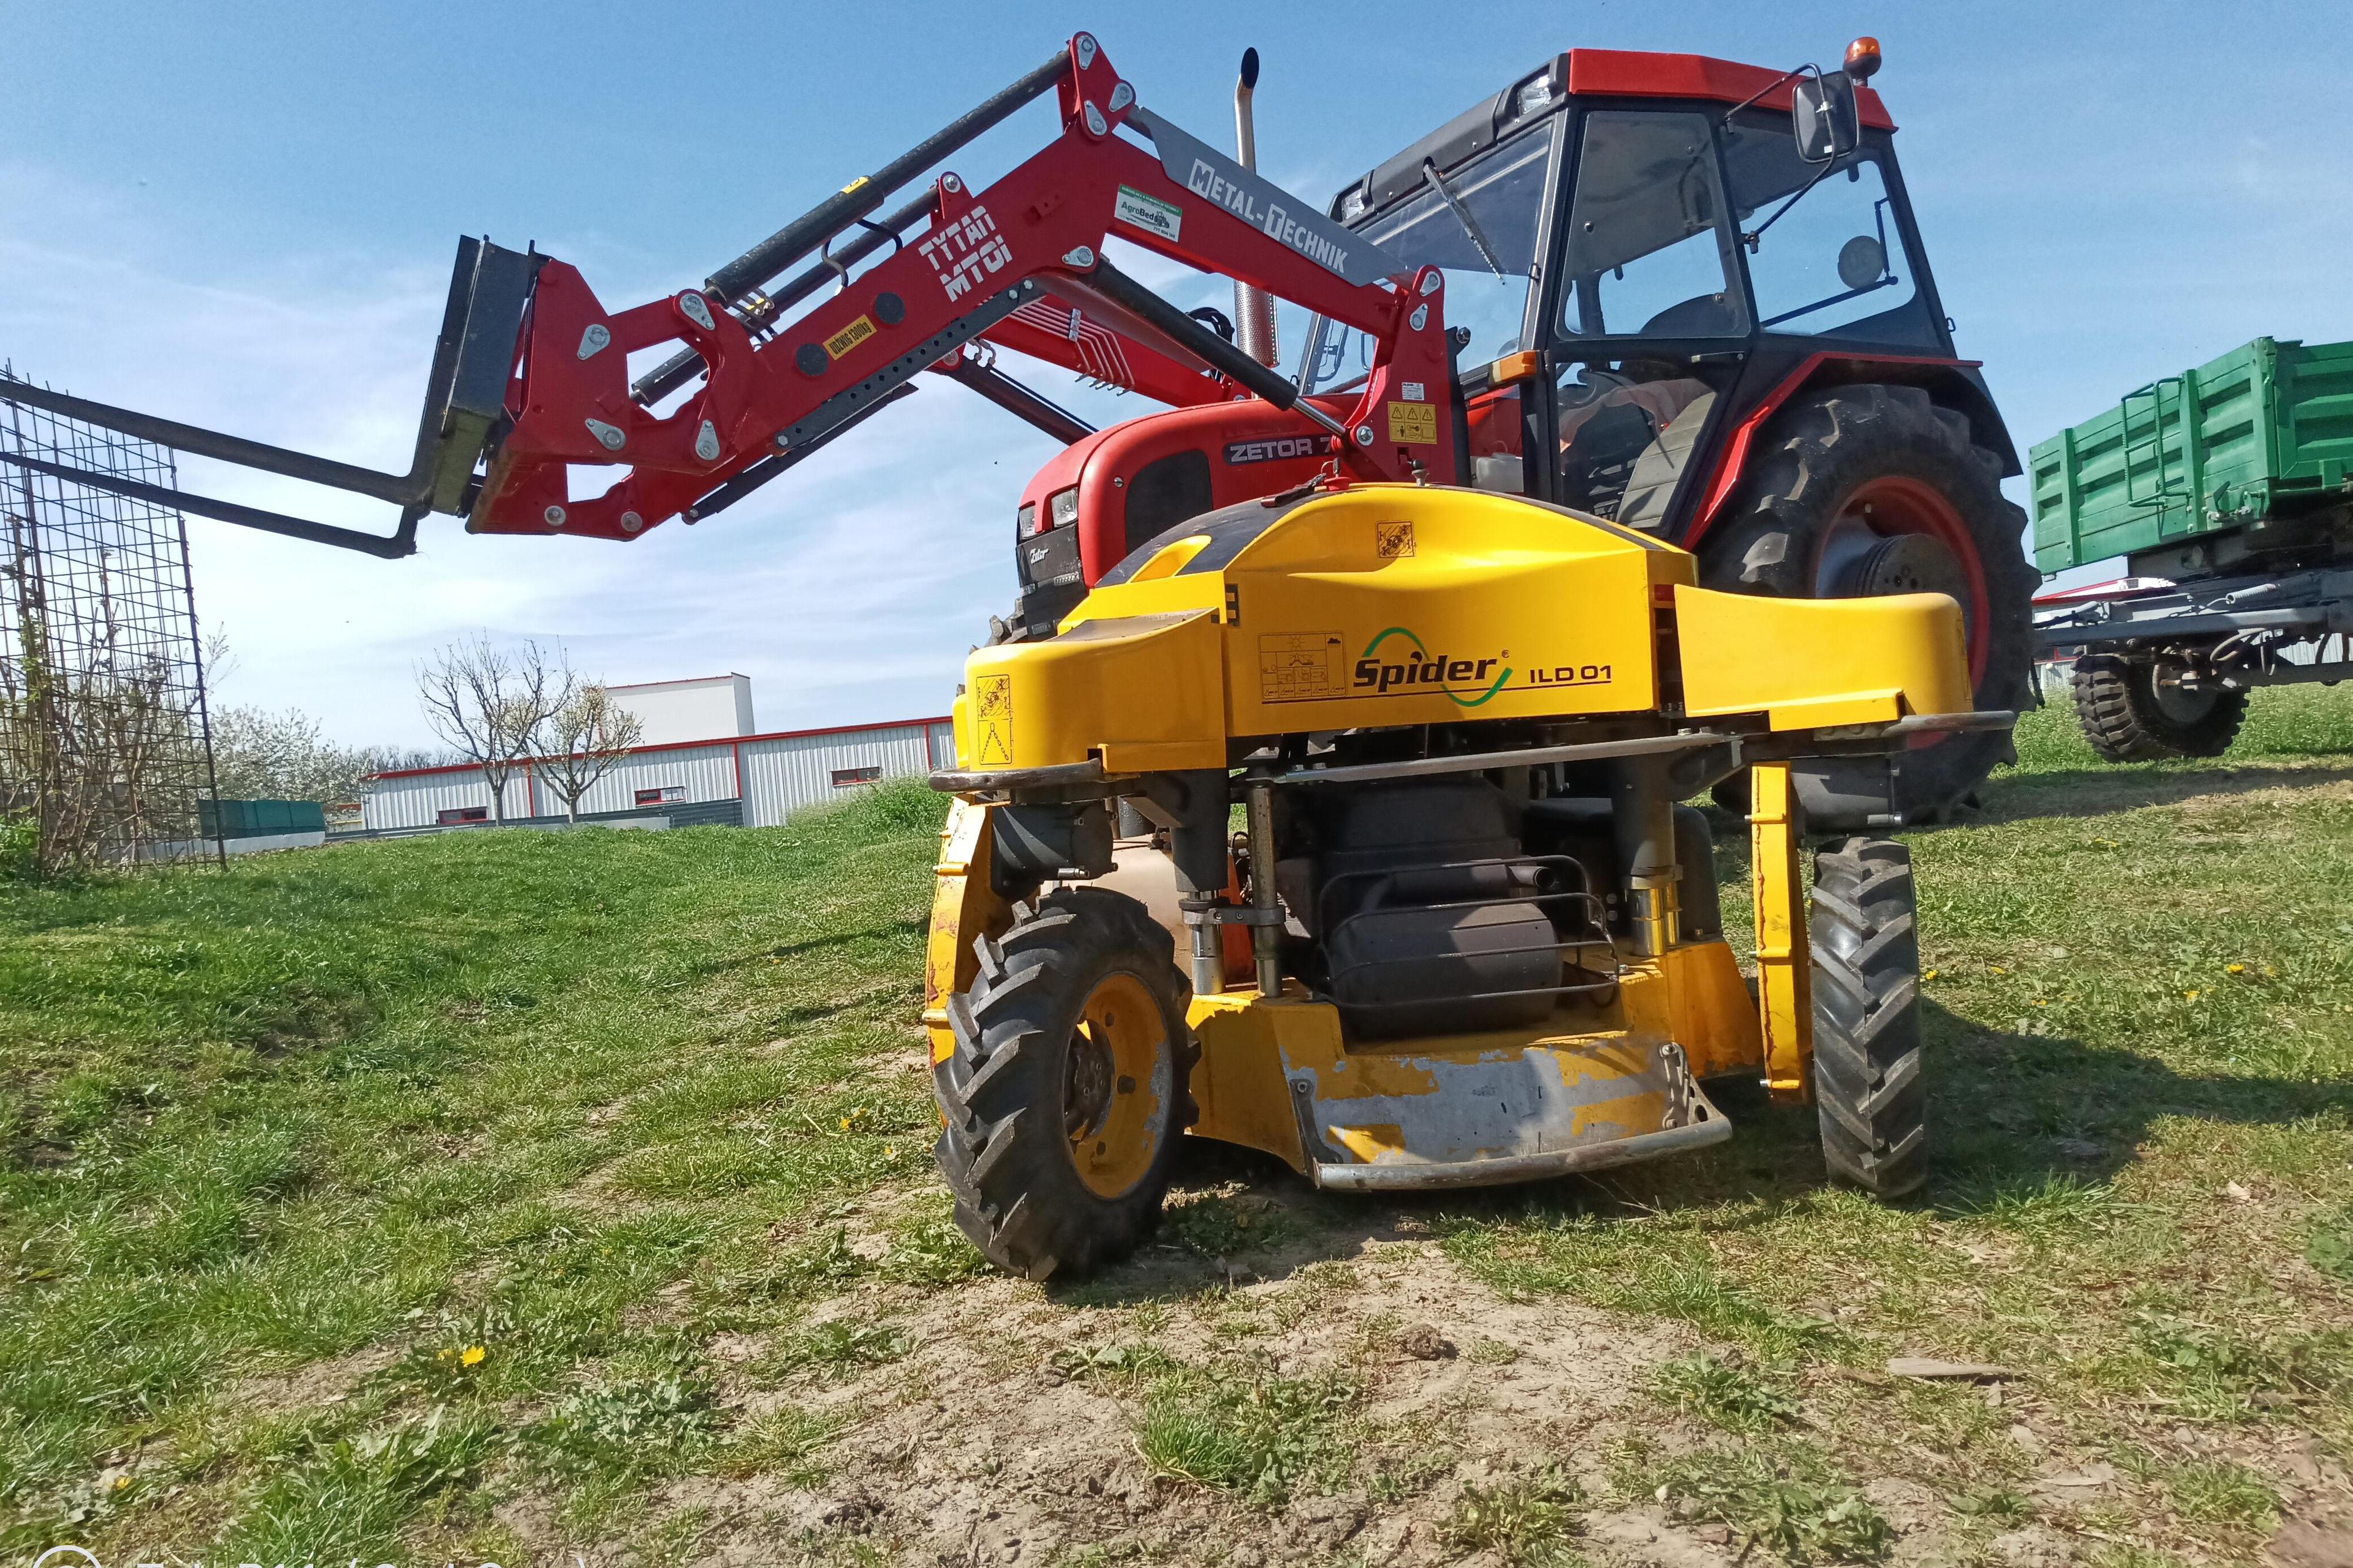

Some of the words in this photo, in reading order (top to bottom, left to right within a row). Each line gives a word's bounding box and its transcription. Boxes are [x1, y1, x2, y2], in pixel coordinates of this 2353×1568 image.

[918, 205, 996, 271] TYTAN
[1188, 158, 1348, 273] METAL-TECHNIK
[1230, 439, 1312, 462] ZETOR
[1354, 651, 1498, 693] Spider
[1530, 667, 1574, 683] ILD
[1581, 665, 1611, 680] 01
